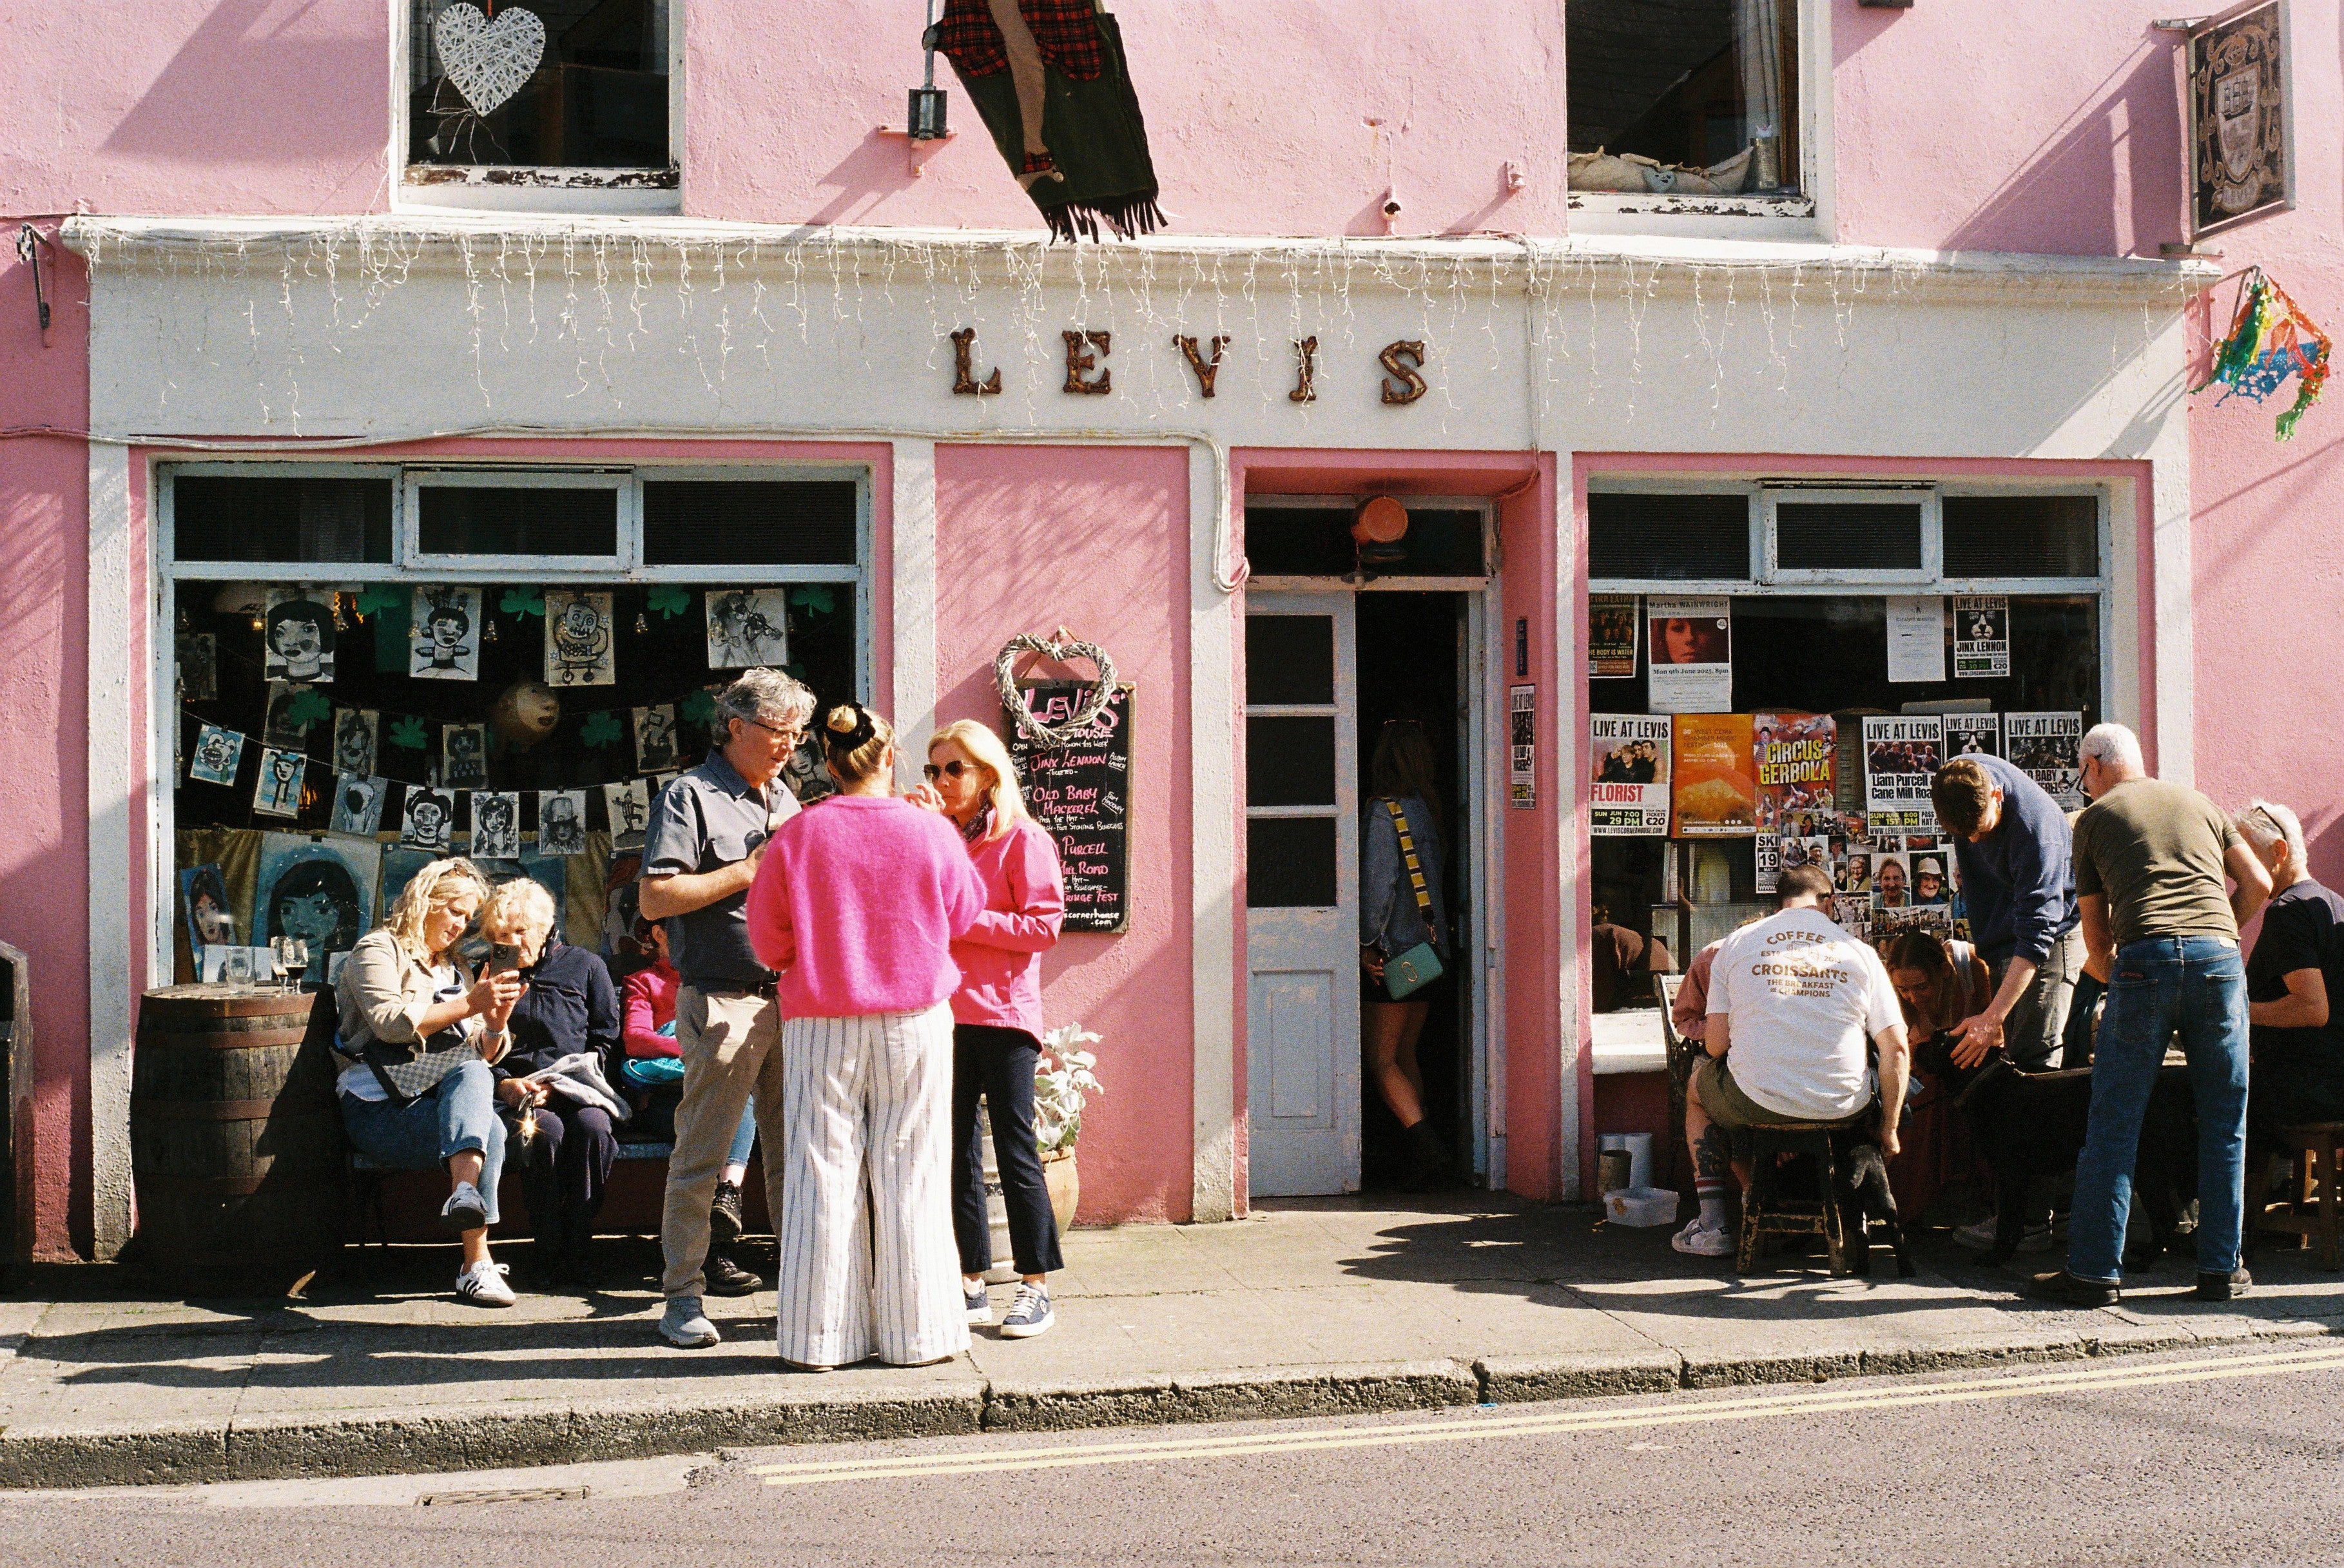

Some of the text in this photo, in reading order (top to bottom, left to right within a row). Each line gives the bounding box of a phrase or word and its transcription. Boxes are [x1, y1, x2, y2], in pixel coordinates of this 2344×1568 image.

[950, 328, 1428, 403] LEVIS
[1957, 641, 2006, 652] JINX LENNON
[1593, 720, 1669, 739] LIVE AT LEVIS
[1946, 717, 1997, 730] LIVE AT LEVIS
[2008, 718, 2080, 735] LIVE AT LEVIS
[1866, 723, 1890, 741] LIVE
[1893, 722, 1906, 740] AT
[1910, 722, 1939, 740] LEVIS
[1012, 743, 1028, 751] OPEN
[1767, 740, 1823, 764] CIRCUS
[1029, 750, 1107, 772] JINX LENNON
[1759, 759, 1831, 785] GERBOLA
[2035, 769, 2057, 781] BABY
[1872, 774, 1895, 786] Liam
[1896, 773, 1928, 786] Purcell
[1034, 788, 1060, 802] OLD
[1066, 785, 1098, 800] BABY
[1591, 784, 1643, 802] FLORIST
[1872, 787, 1932, 799] Cane Mill Roa
[1043, 800, 1099, 815] MACKEREL
[1609, 817, 1640, 826] 29 PM
[1062, 835, 1109, 855] PURCELL
[1759, 853, 1777, 866] 19
[1078, 861, 1108, 875] ROAD
[1097, 889, 1119, 902] FEST
[1767, 931, 1826, 945] COFFEE
[1752, 964, 1848, 983] CROISSANTS
[1785, 980, 1835, 989] BREAKFAST
[1779, 988, 1830, 998] CHAMPIONS
